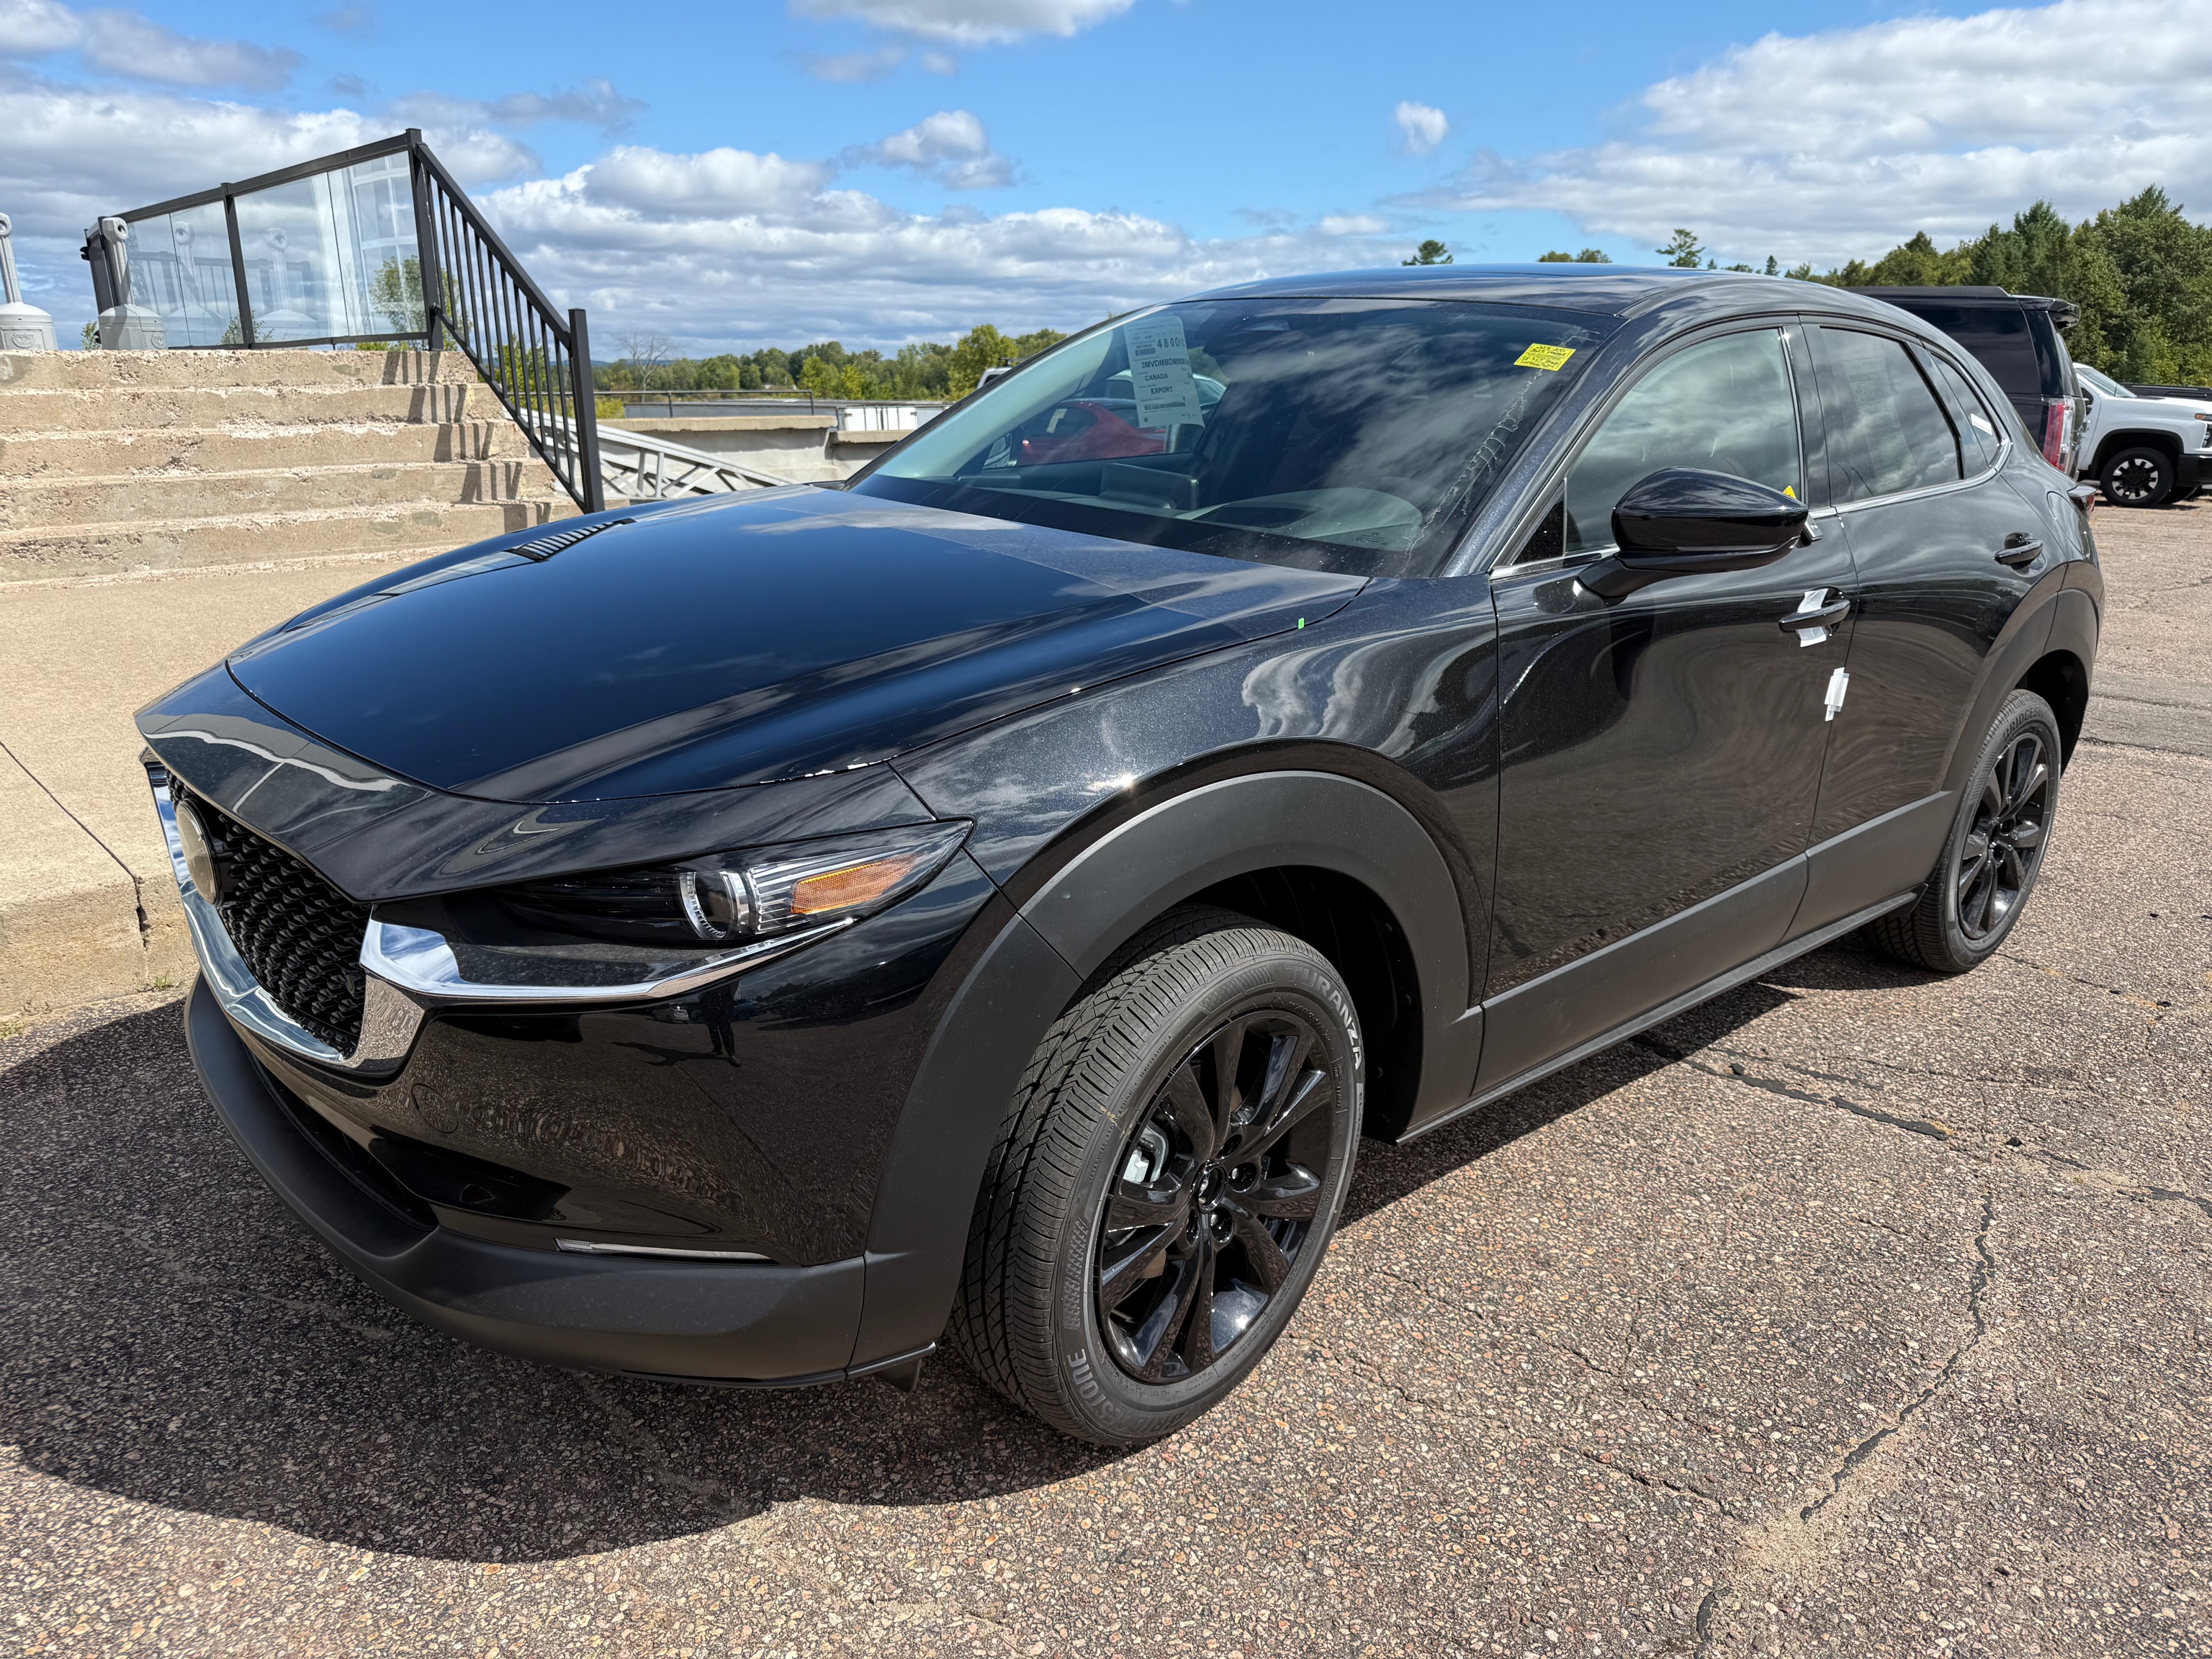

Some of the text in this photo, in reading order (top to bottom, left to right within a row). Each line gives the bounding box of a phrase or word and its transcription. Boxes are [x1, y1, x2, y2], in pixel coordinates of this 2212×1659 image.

[1145, 373, 1169, 382] CANADA
[1151, 386, 1173, 395] EXPORT
[1285, 964, 1362, 1071] TURANZA
